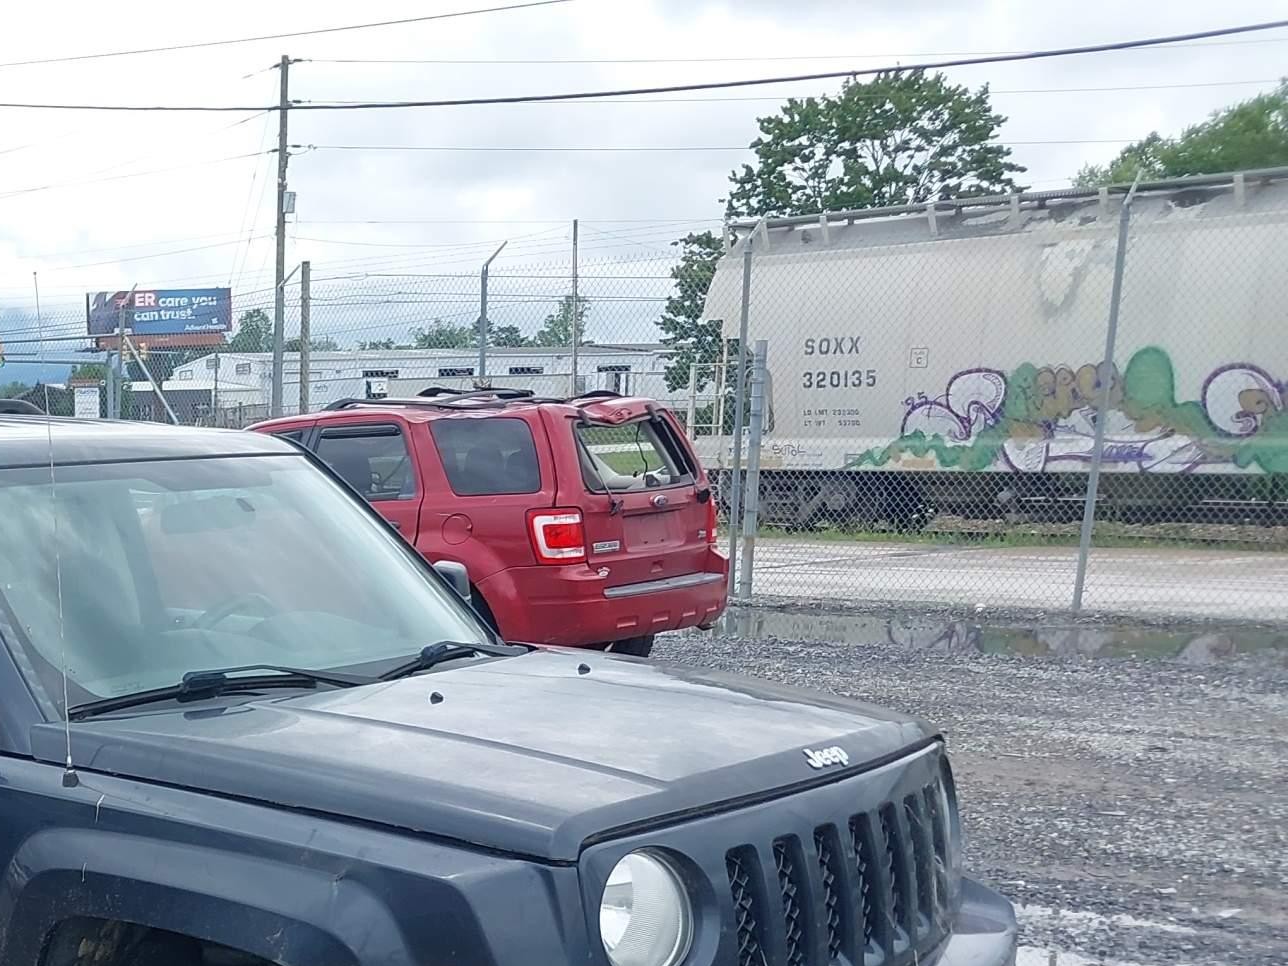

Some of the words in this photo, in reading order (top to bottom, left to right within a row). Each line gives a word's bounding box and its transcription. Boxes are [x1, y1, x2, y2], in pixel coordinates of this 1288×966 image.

[135, 293, 155, 307] ER
[158, 297, 188, 307] care
[192, 295, 217, 309] you
[135, 311, 159, 321] can
[162, 309, 196, 320] trust.
[804, 336, 860, 355] SOXX
[802, 369, 876, 388] 320135
[802, 745, 849, 768] Jeep
